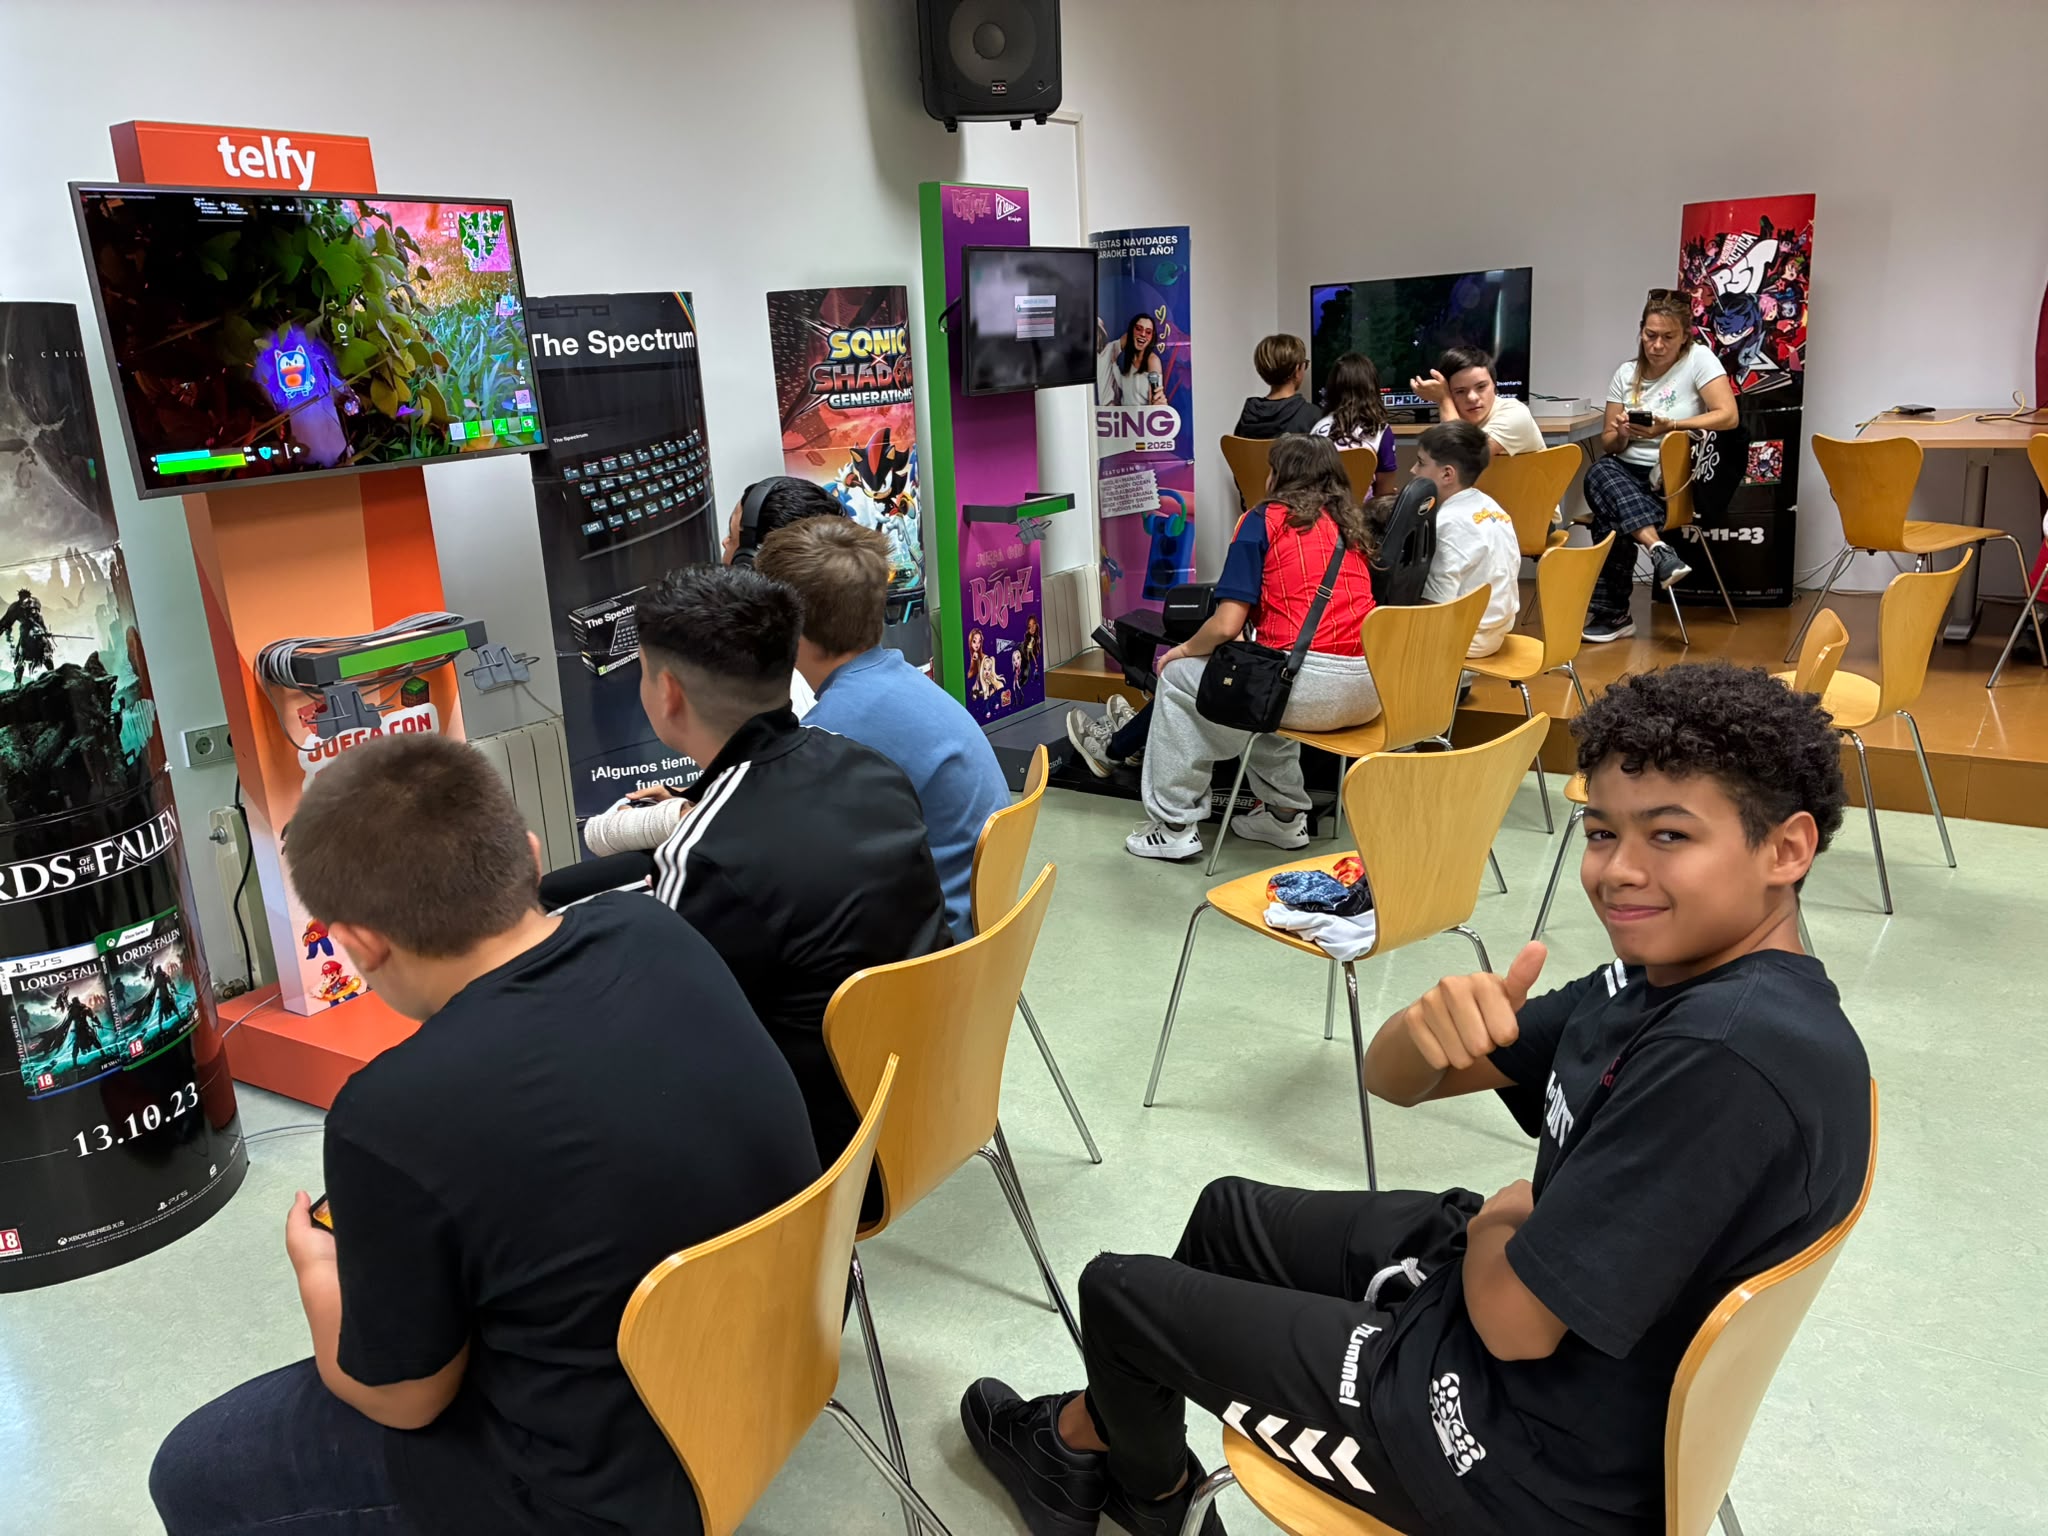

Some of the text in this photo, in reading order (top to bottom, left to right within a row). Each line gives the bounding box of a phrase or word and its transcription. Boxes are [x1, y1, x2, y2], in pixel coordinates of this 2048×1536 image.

[218, 136, 316, 192] telfy
[1098, 244, 1174, 259] ARAOKE DEL AÑO!
[1100, 240, 1121, 249] ESTAS
[1123, 235, 1178, 247] NAVIDADES
[1726, 233, 1758, 266] TACTICA
[531, 328, 695, 358] The Spectrum
[829, 328, 907, 359] SONIC
[829, 387, 912, 407] GENERATIONS
[1096, 410, 1175, 438] SiNG
[563, 432, 589, 442] Spectrum
[1147, 441, 1173, 450] 2025
[1681, 527, 1765, 544] 17-11-23
[969, 566, 1034, 628] BRATZ
[585, 604, 637, 629] The Spectr
[389, 713, 432, 737] CON
[591, 762, 658, 782] ¡Algunos
[636, 775, 683, 791] fueron
[1211, 795, 1255, 807] ayseat
[92, 805, 178, 878] FALLEN
[77, 863, 96, 874] THE
[79, 856, 91, 866] OF
[154, 927, 180, 950] FALLEN
[29, 956, 62, 970] PS5
[116, 942, 153, 965] LORDS
[20, 971, 67, 992] LORDS
[71, 963, 100, 980] FALL
[130, 1041, 143, 1054] 18
[38, 1074, 53, 1088] 18
[73, 1081, 199, 1158] 13.10.23
[0, 1231, 19, 1251] 18
[67, 1232, 88, 1243] XBOX
[1338, 1323, 1383, 1408] hummel
